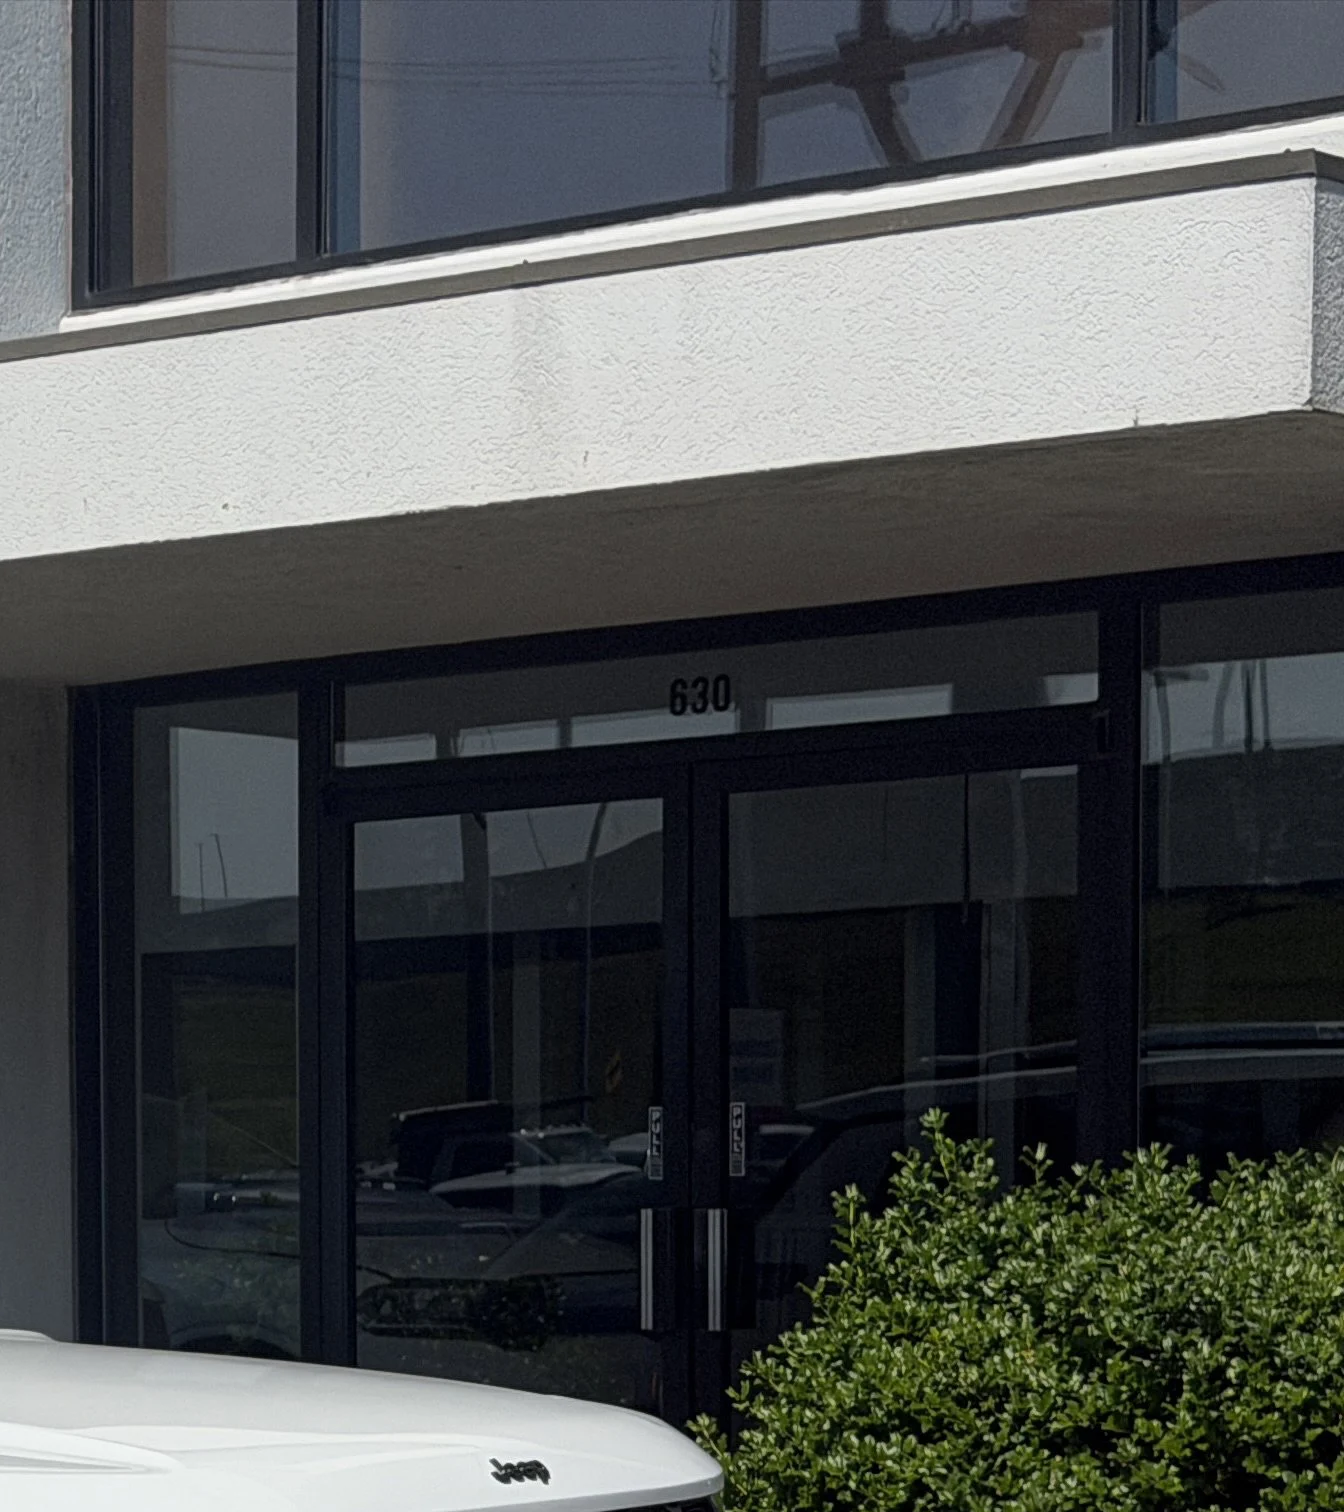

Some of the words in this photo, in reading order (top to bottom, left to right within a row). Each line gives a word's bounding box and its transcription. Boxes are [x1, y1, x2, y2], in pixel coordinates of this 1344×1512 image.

[669, 673, 731, 716] 630
[651, 1110, 662, 1157] PULL
[732, 1106, 743, 1153] PULL
